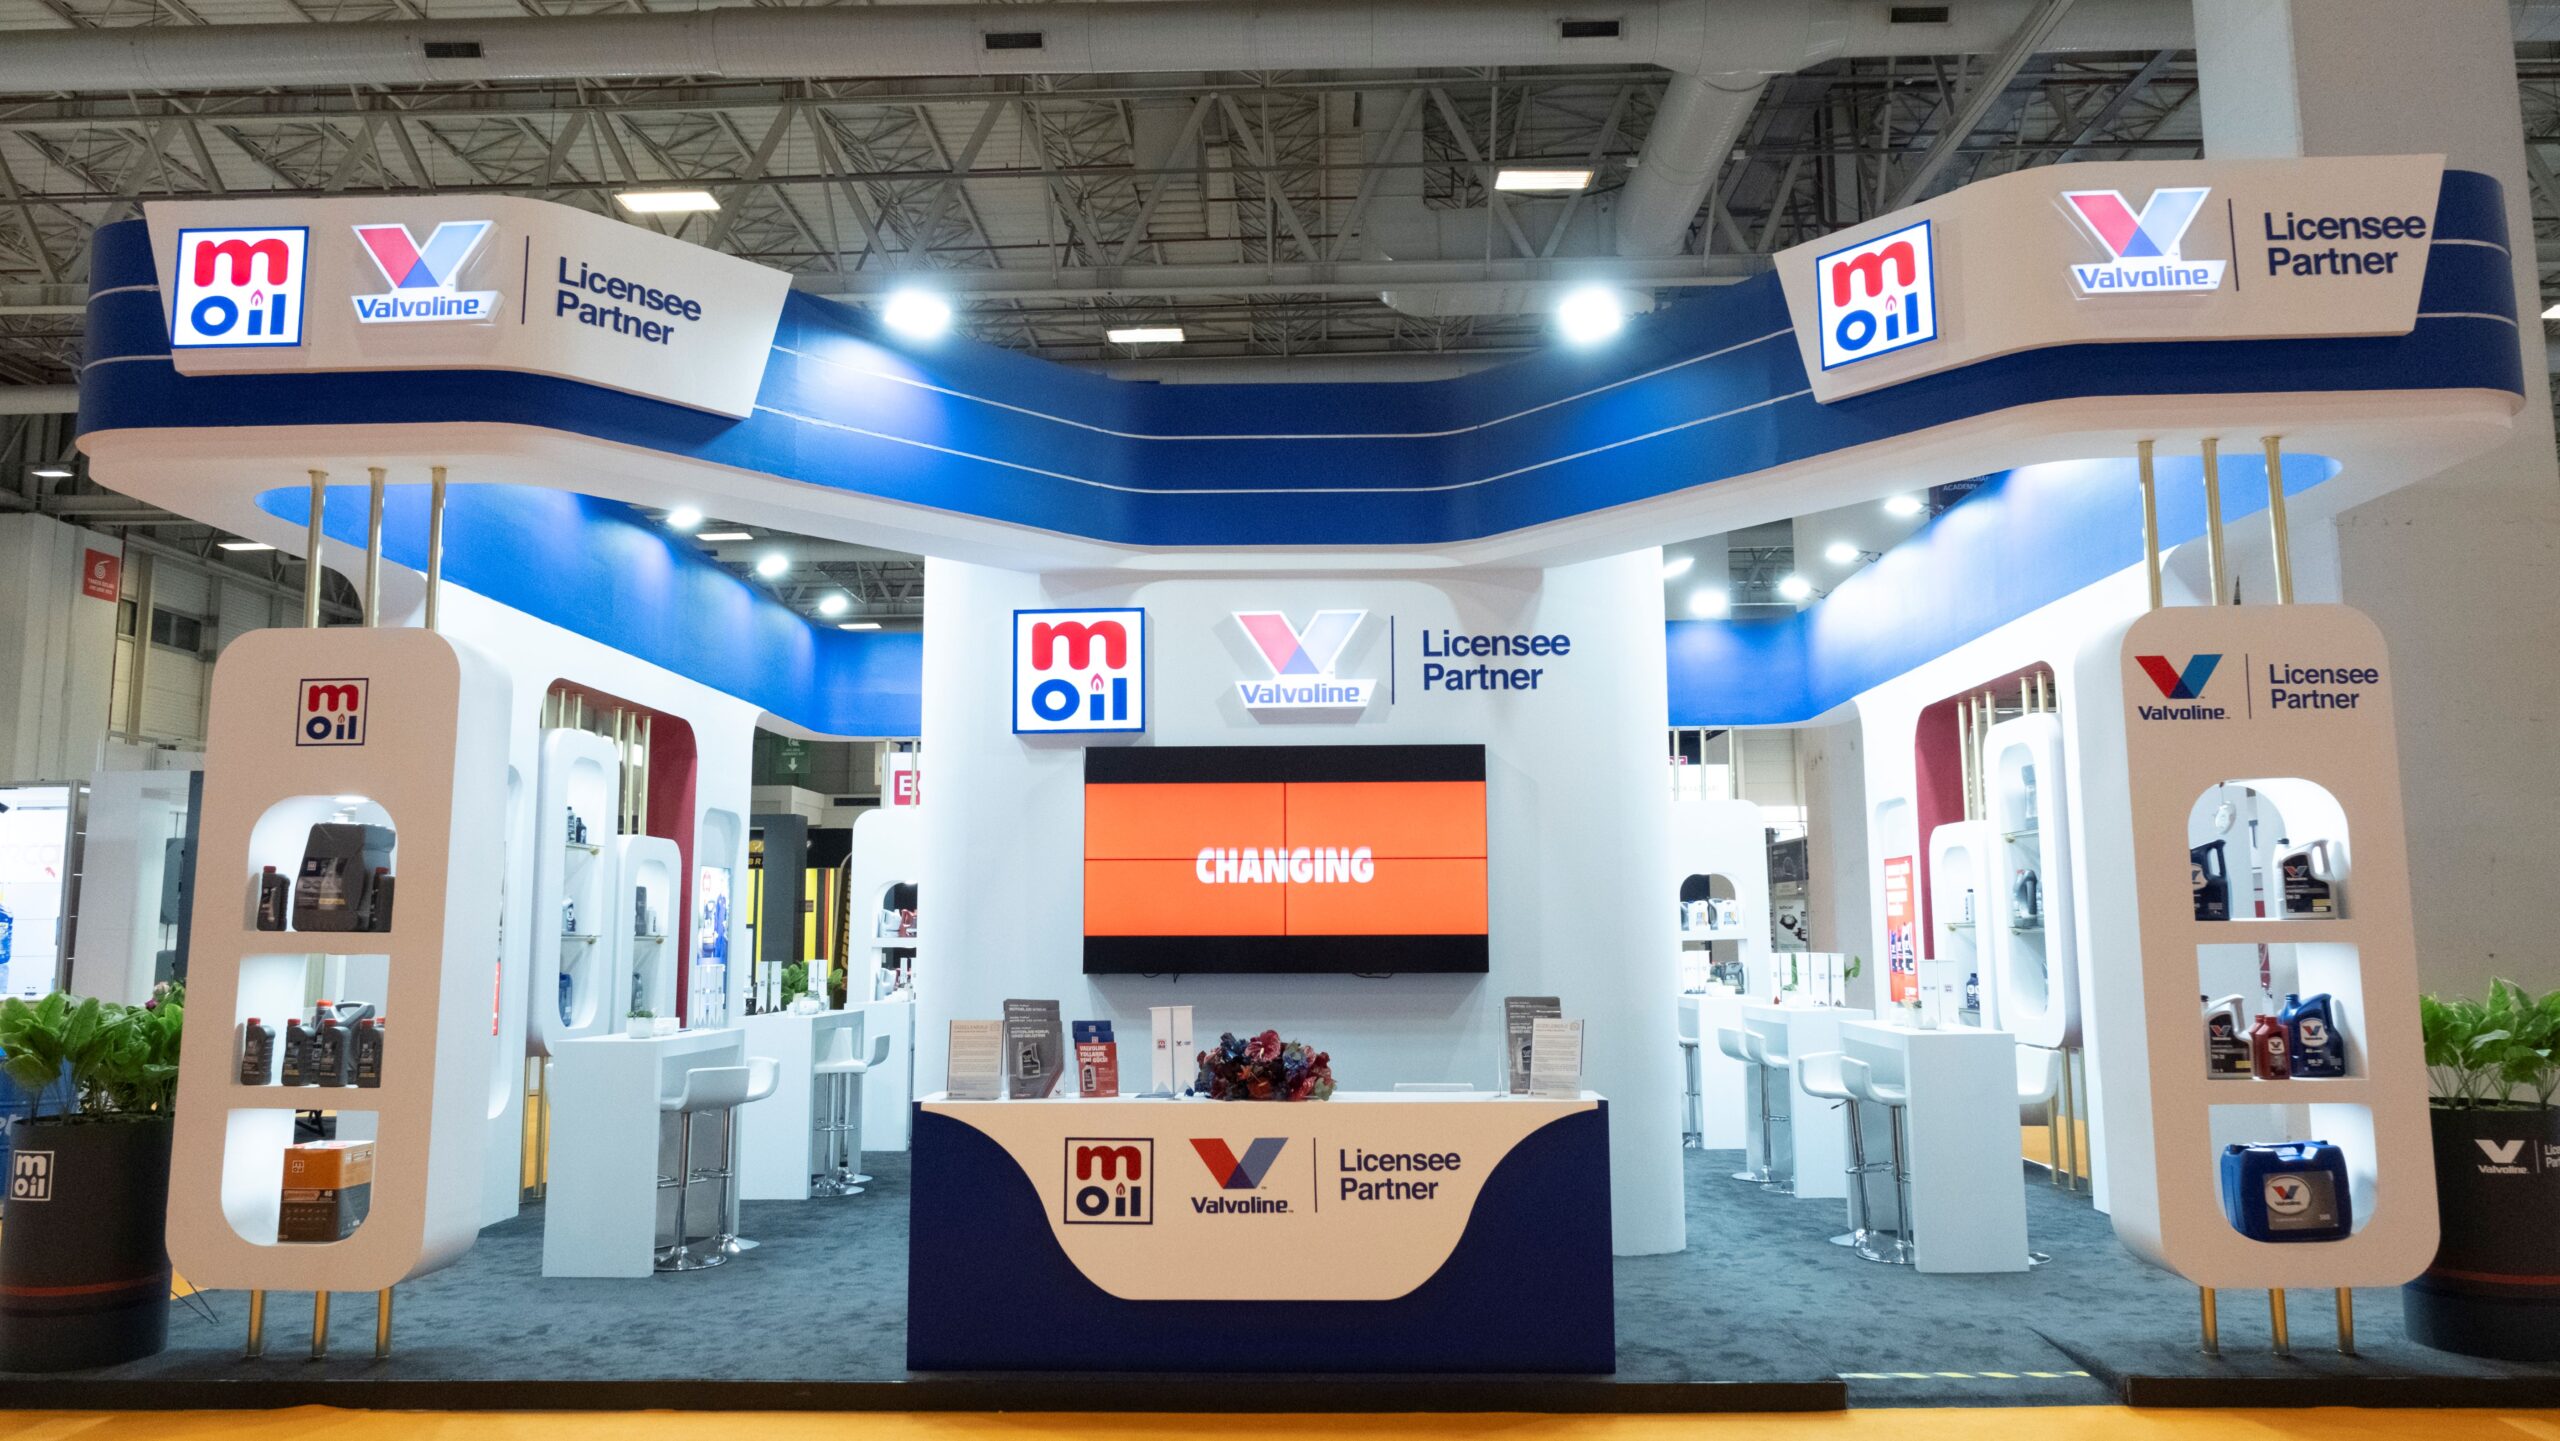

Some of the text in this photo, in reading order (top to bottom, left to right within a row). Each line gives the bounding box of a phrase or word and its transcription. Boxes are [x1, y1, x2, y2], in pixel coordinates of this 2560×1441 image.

[2264, 212, 2427, 241] Licensee
[2267, 247, 2398, 276] Partner
[558, 256, 702, 321] Licensee
[2077, 265, 2209, 289] Valvoline
[190, 290, 287, 336] oil
[357, 296, 480, 319] Valvoline
[556, 290, 674, 345] Partner
[1836, 292, 1919, 351] oil
[1422, 629, 1571, 657] Licensee
[1423, 663, 1544, 691] Partner
[2269, 664, 2379, 685] Licensee
[1031, 676, 1128, 722] oil
[1239, 683, 1360, 704] Valvoline
[2271, 688, 2360, 709] Partner
[2138, 705, 2225, 720] Valvoline
[306, 714, 357, 740] oil
[1196, 846, 1375, 884] CHANGING
[1339, 1148, 1461, 1172] Licensee
[2478, 1164, 2528, 1175] Valvoline
[1076, 1184, 1142, 1217] oil
[1339, 1177, 1439, 1201] Partner
[1191, 1196, 1289, 1214] Valvoline
